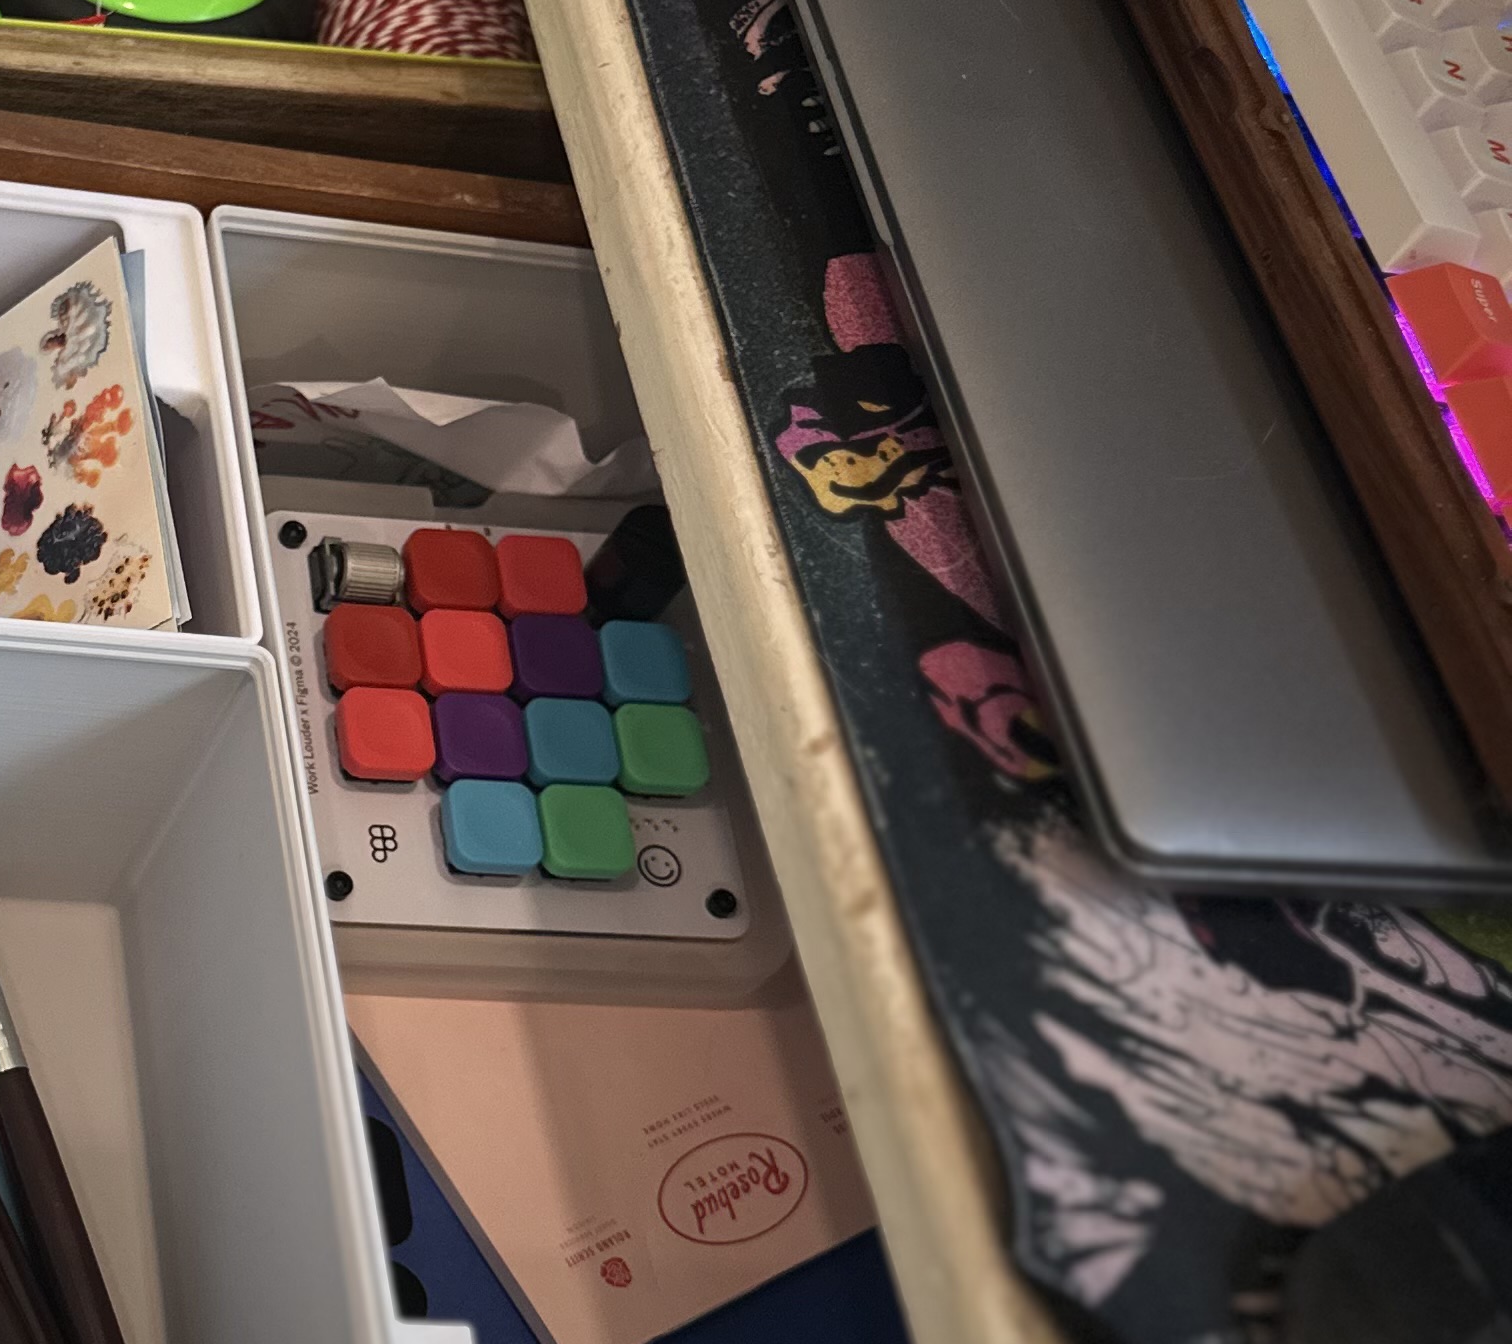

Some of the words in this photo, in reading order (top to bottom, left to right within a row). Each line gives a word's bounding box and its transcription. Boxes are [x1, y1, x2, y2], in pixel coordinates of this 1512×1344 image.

[1443, 59, 1467, 82] N
[1487, 138, 1512, 165] M
[286, 621, 301, 653] 2024
[294, 668, 310, 707] Figma
[299, 717, 315, 760] Louder
[303, 760, 320, 796] Work
[683, 1159, 742, 1193] MOTEL
[689, 1146, 790, 1236] Rosebud
